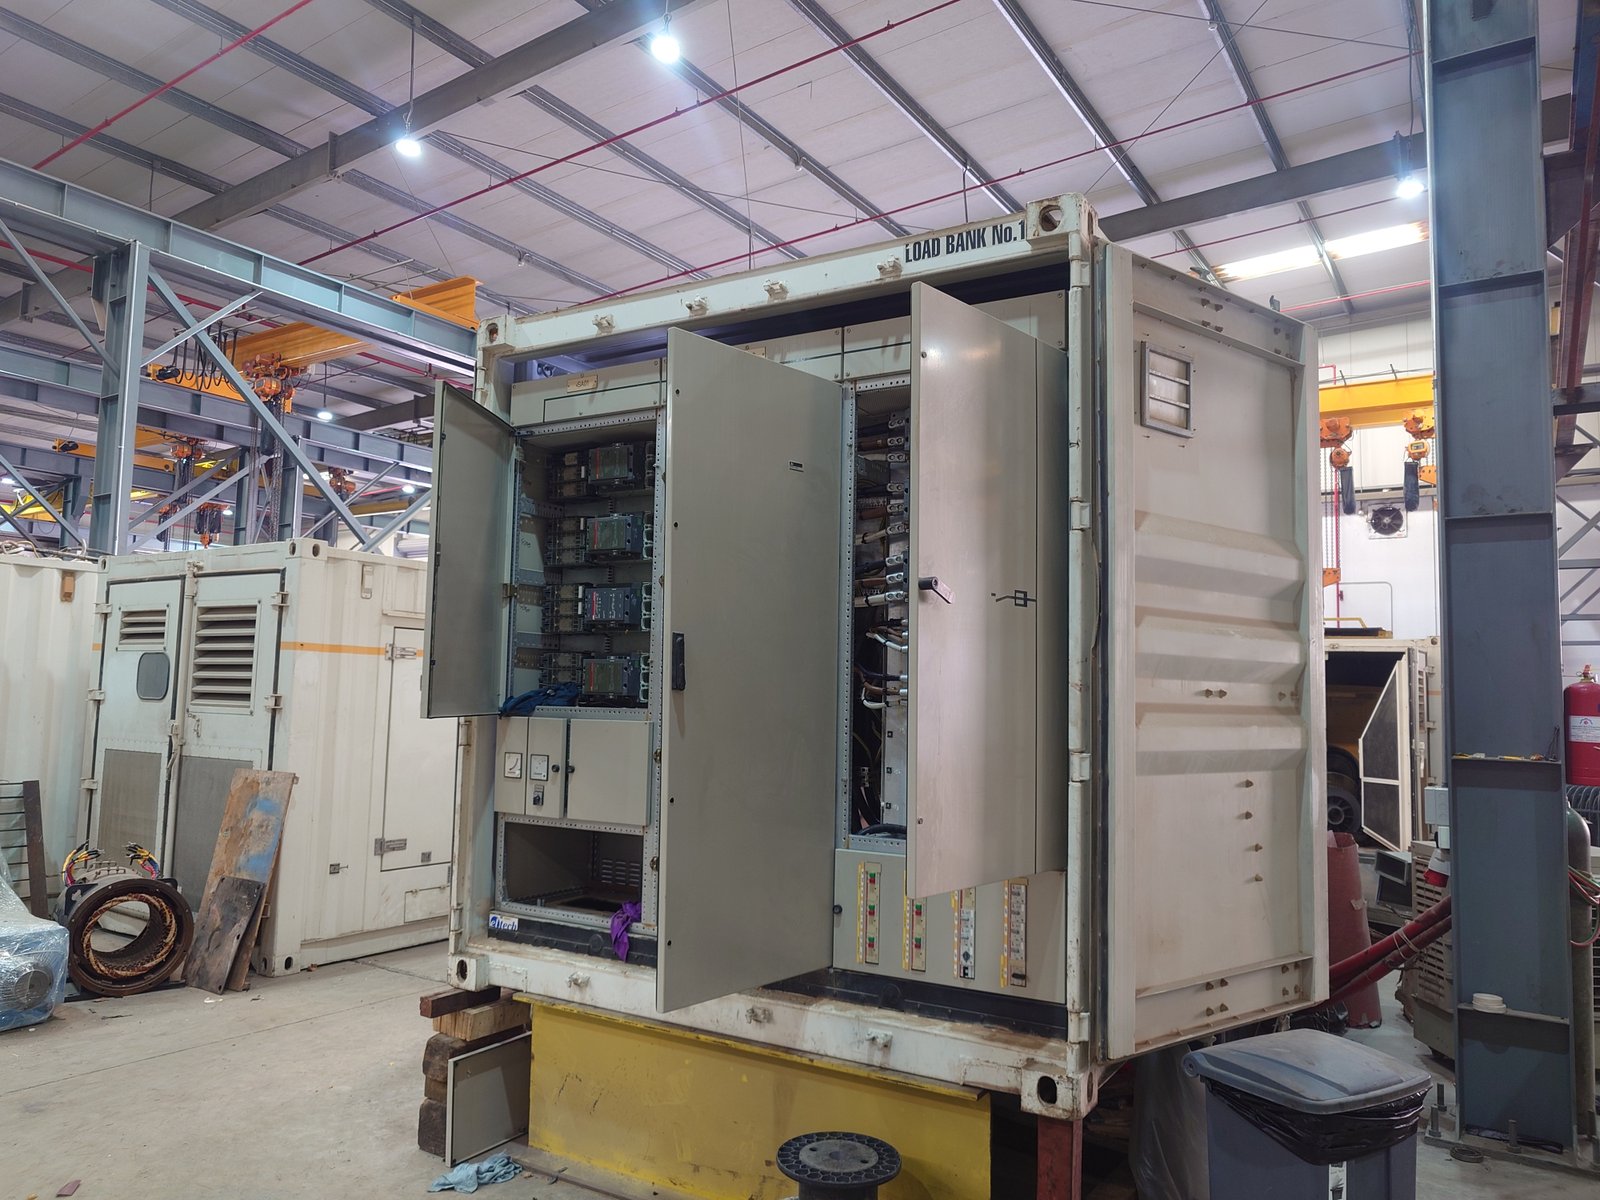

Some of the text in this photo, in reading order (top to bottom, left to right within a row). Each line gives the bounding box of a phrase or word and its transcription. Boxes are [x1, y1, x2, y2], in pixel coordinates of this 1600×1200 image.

[905, 220, 1025, 263] LOAD BANK No.1
